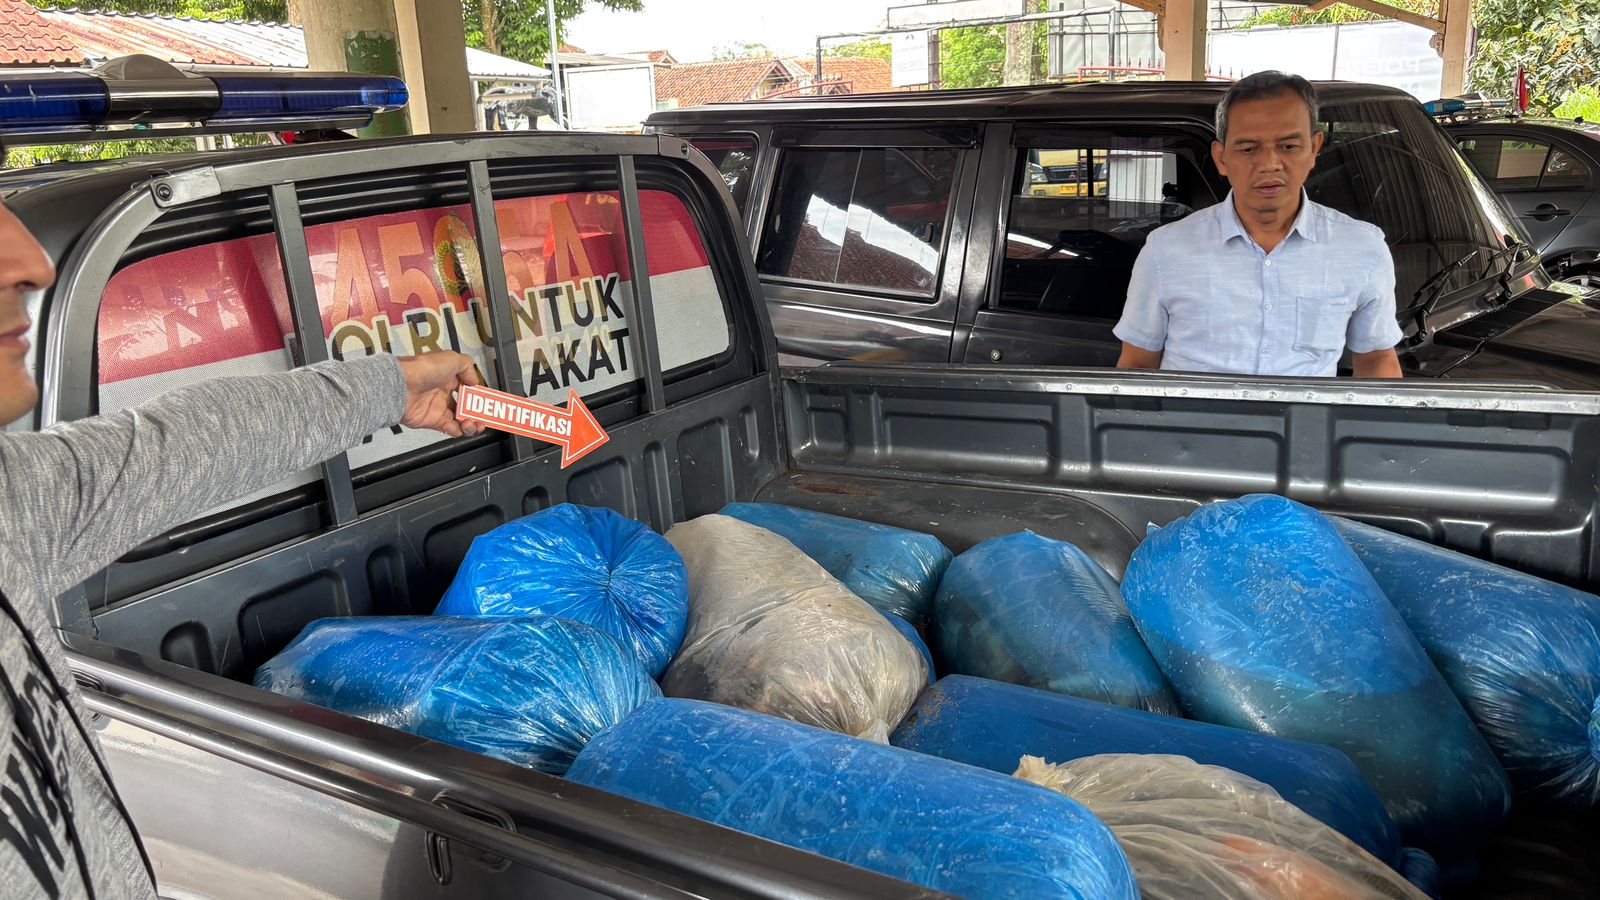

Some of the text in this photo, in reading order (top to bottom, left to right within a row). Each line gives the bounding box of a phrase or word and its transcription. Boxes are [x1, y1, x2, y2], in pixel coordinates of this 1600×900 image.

[289, 306, 461, 367] ORI
[471, 276, 624, 347] UNTUK
[524, 328, 629, 397] AKAT
[465, 393, 573, 437] IDENTIFIKASI
